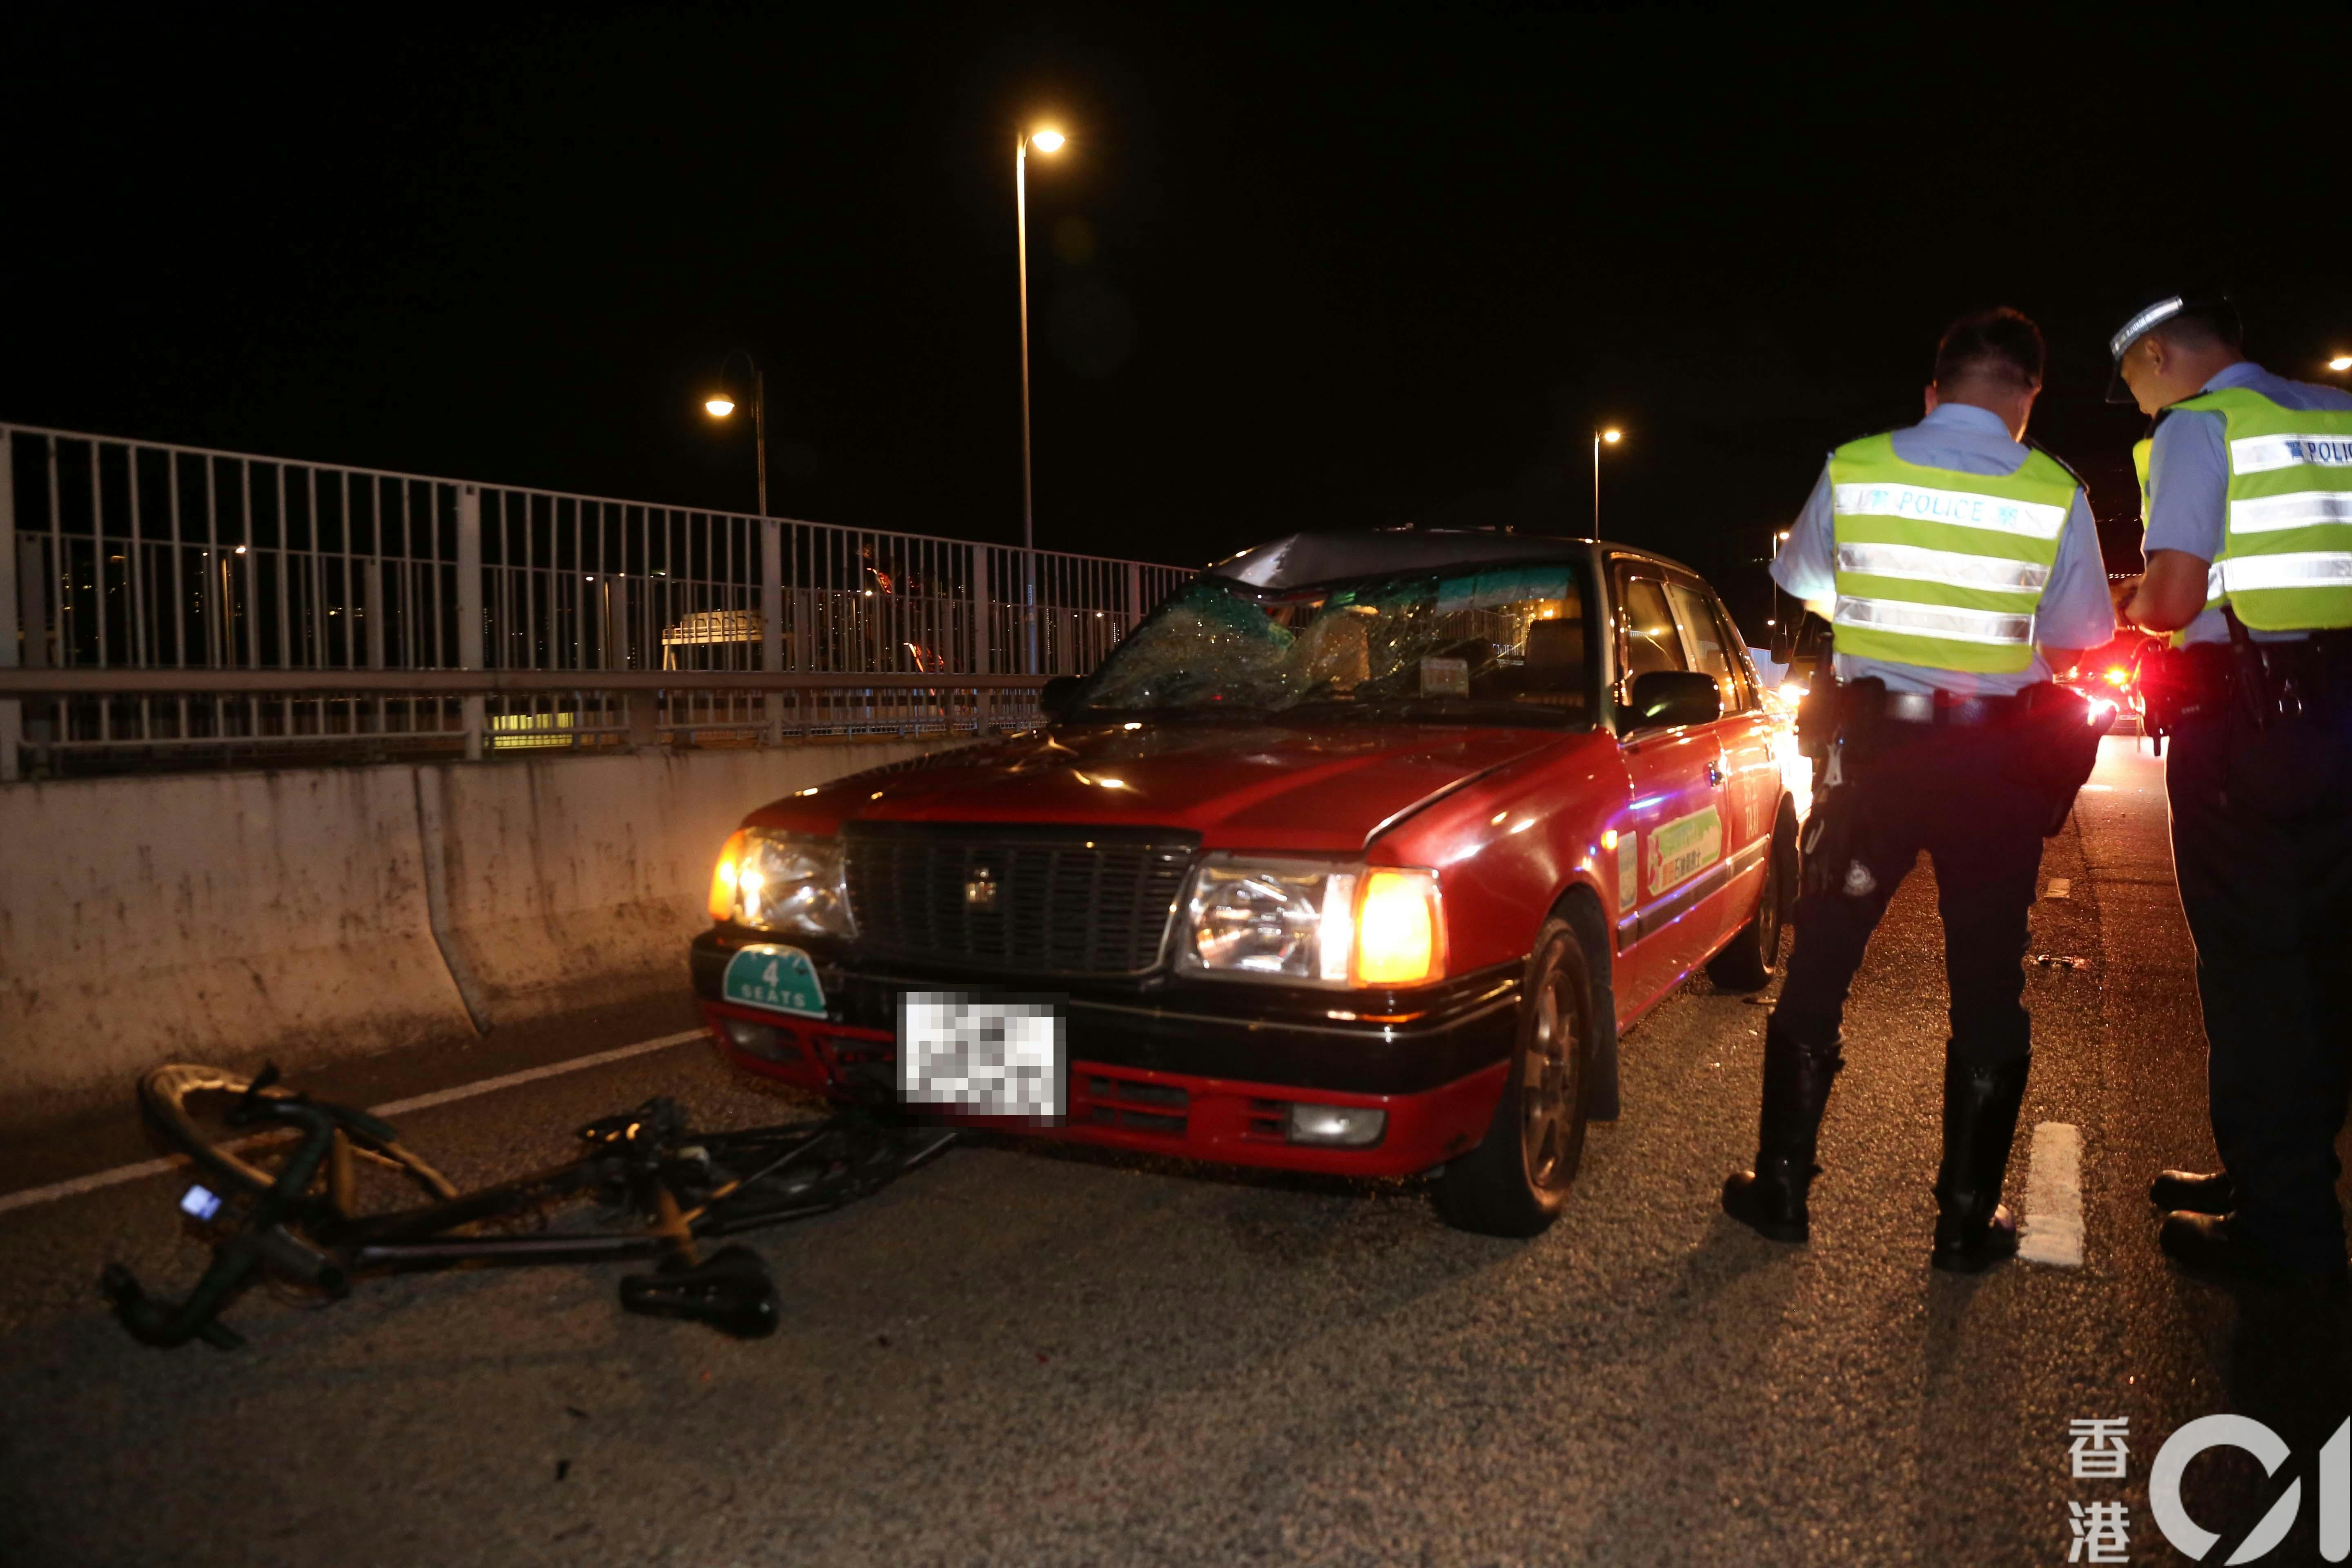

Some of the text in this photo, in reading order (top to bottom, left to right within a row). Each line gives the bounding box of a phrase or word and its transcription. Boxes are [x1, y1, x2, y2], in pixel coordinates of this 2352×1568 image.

[1900, 491, 1984, 521] POLICE
[762, 960, 780, 987] 4
[741, 984, 805, 1008] SEATS
